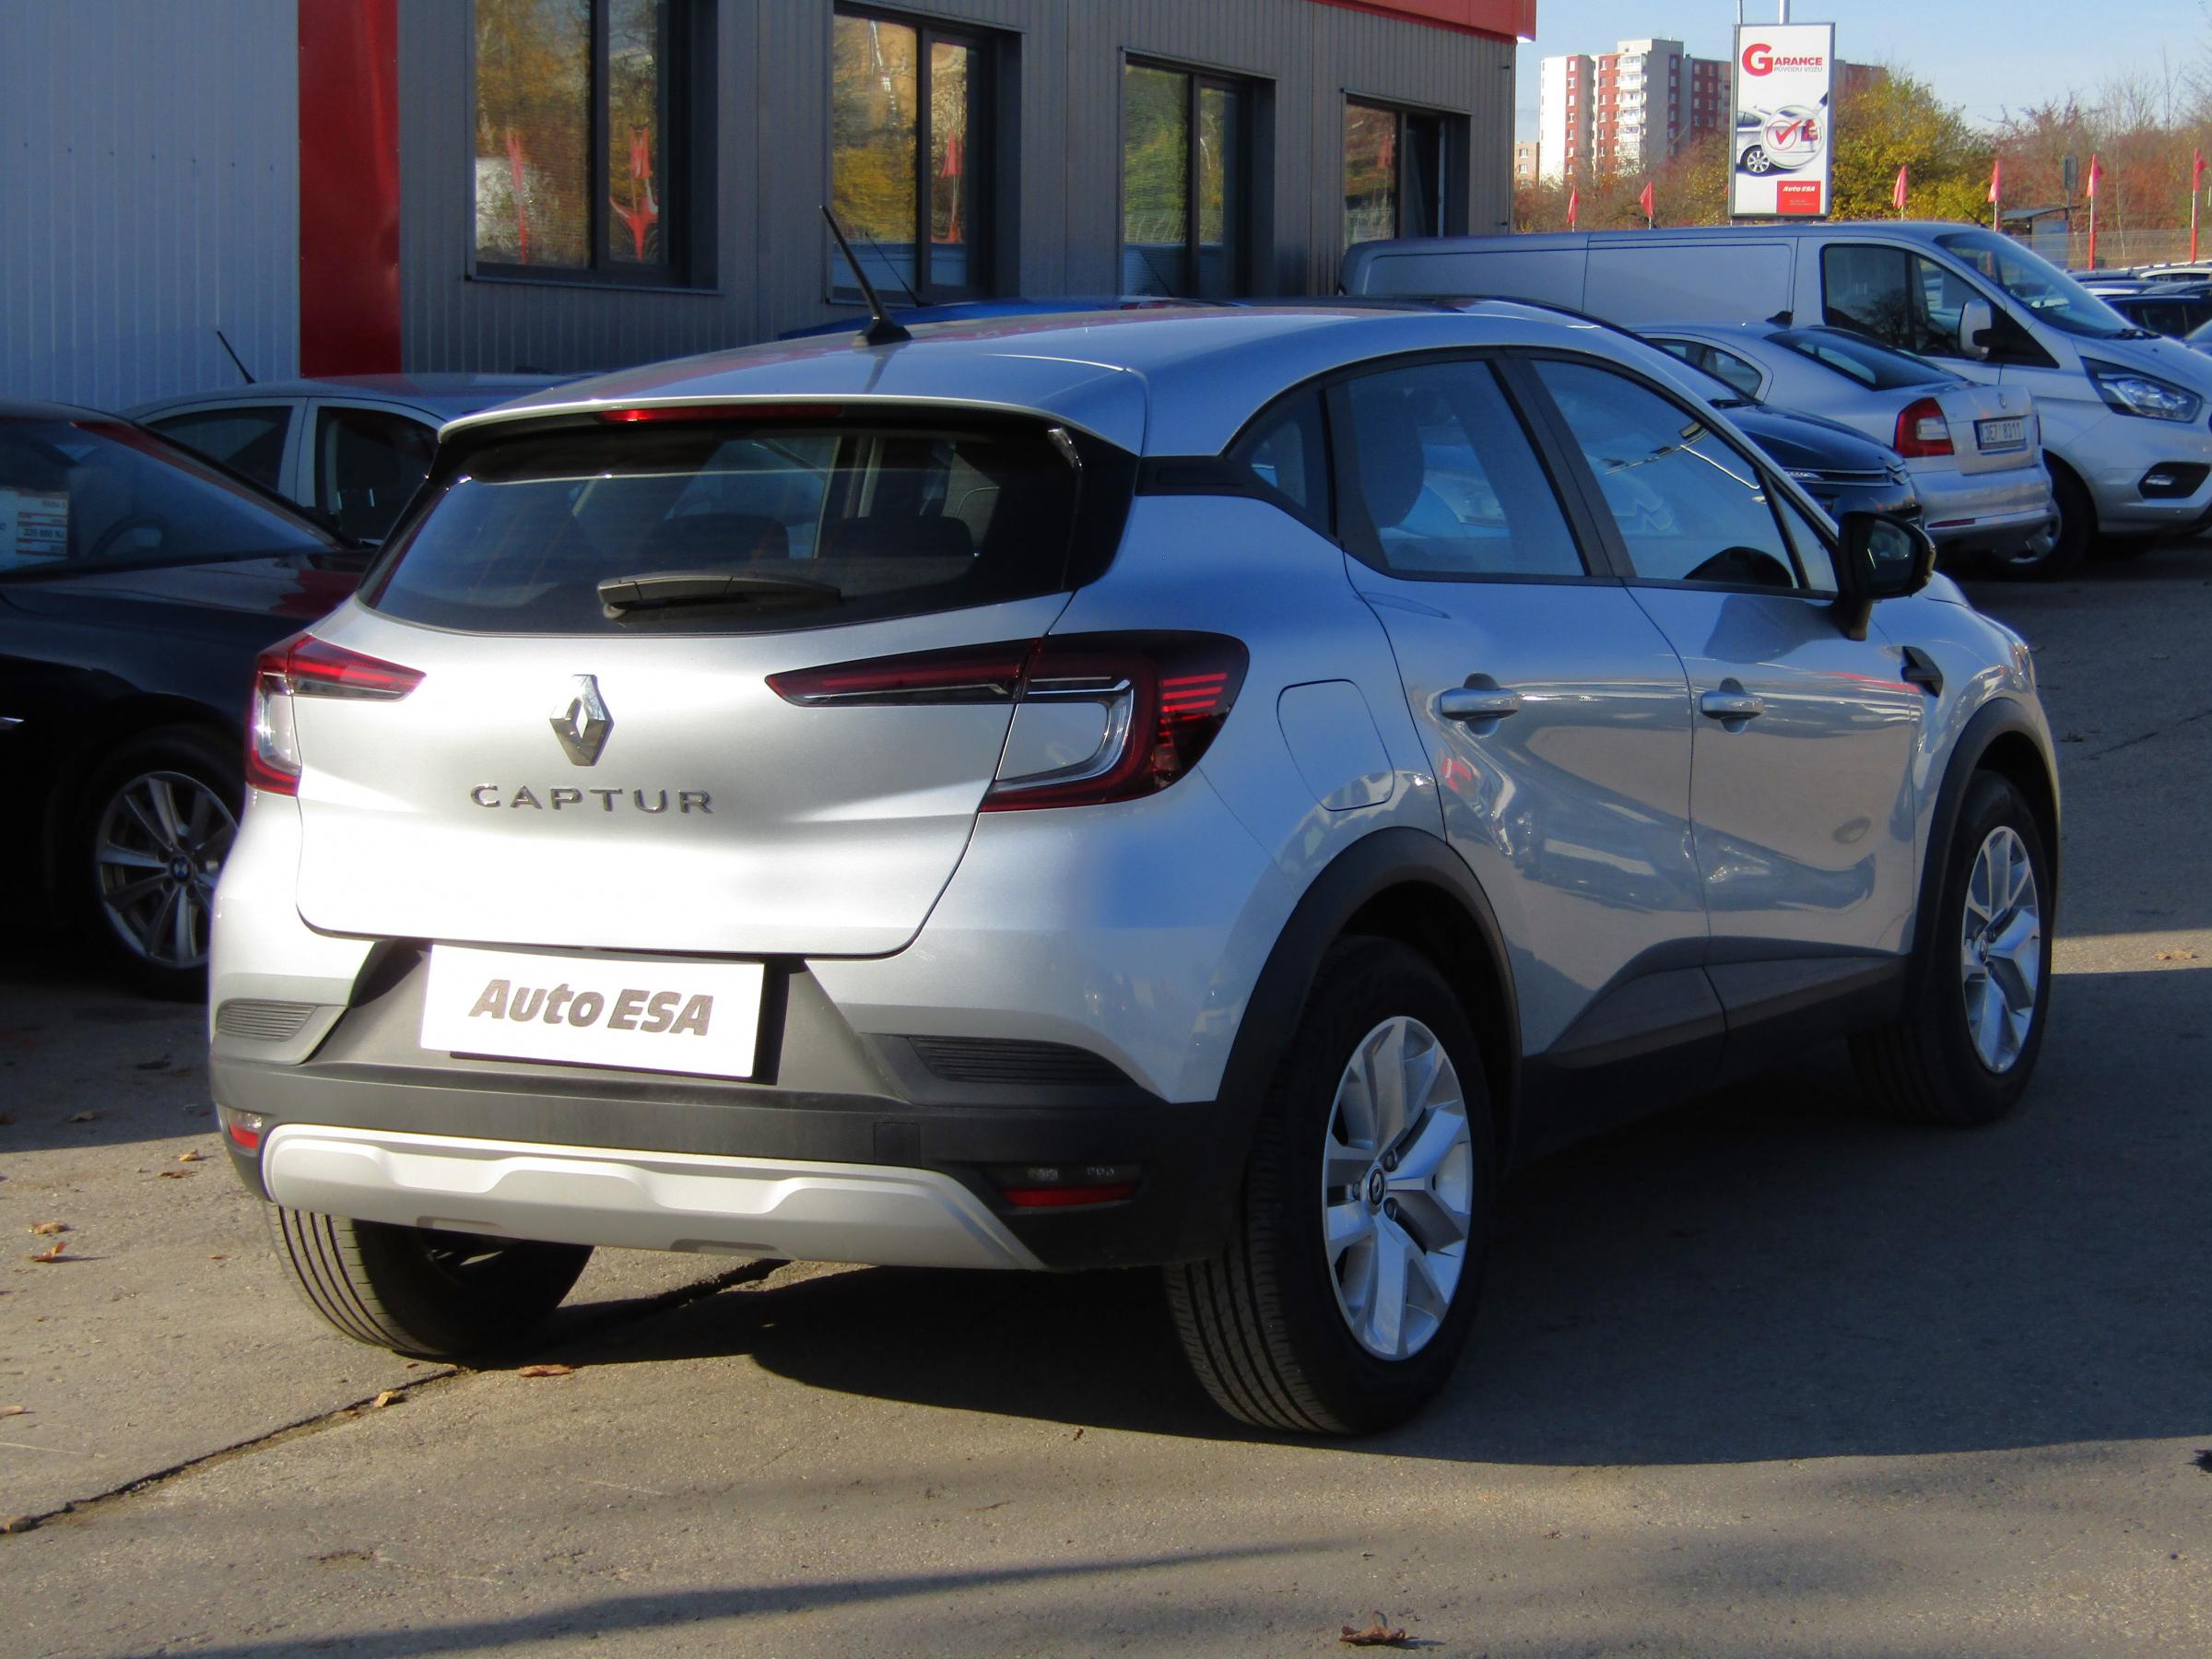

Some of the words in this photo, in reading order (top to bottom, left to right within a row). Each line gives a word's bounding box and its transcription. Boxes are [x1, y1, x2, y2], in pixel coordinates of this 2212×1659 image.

[1742, 43, 1823, 77] GARANCE
[470, 782, 713, 814] CAPTUR
[468, 978, 605, 1028] Auto
[607, 988, 714, 1037] ESA
